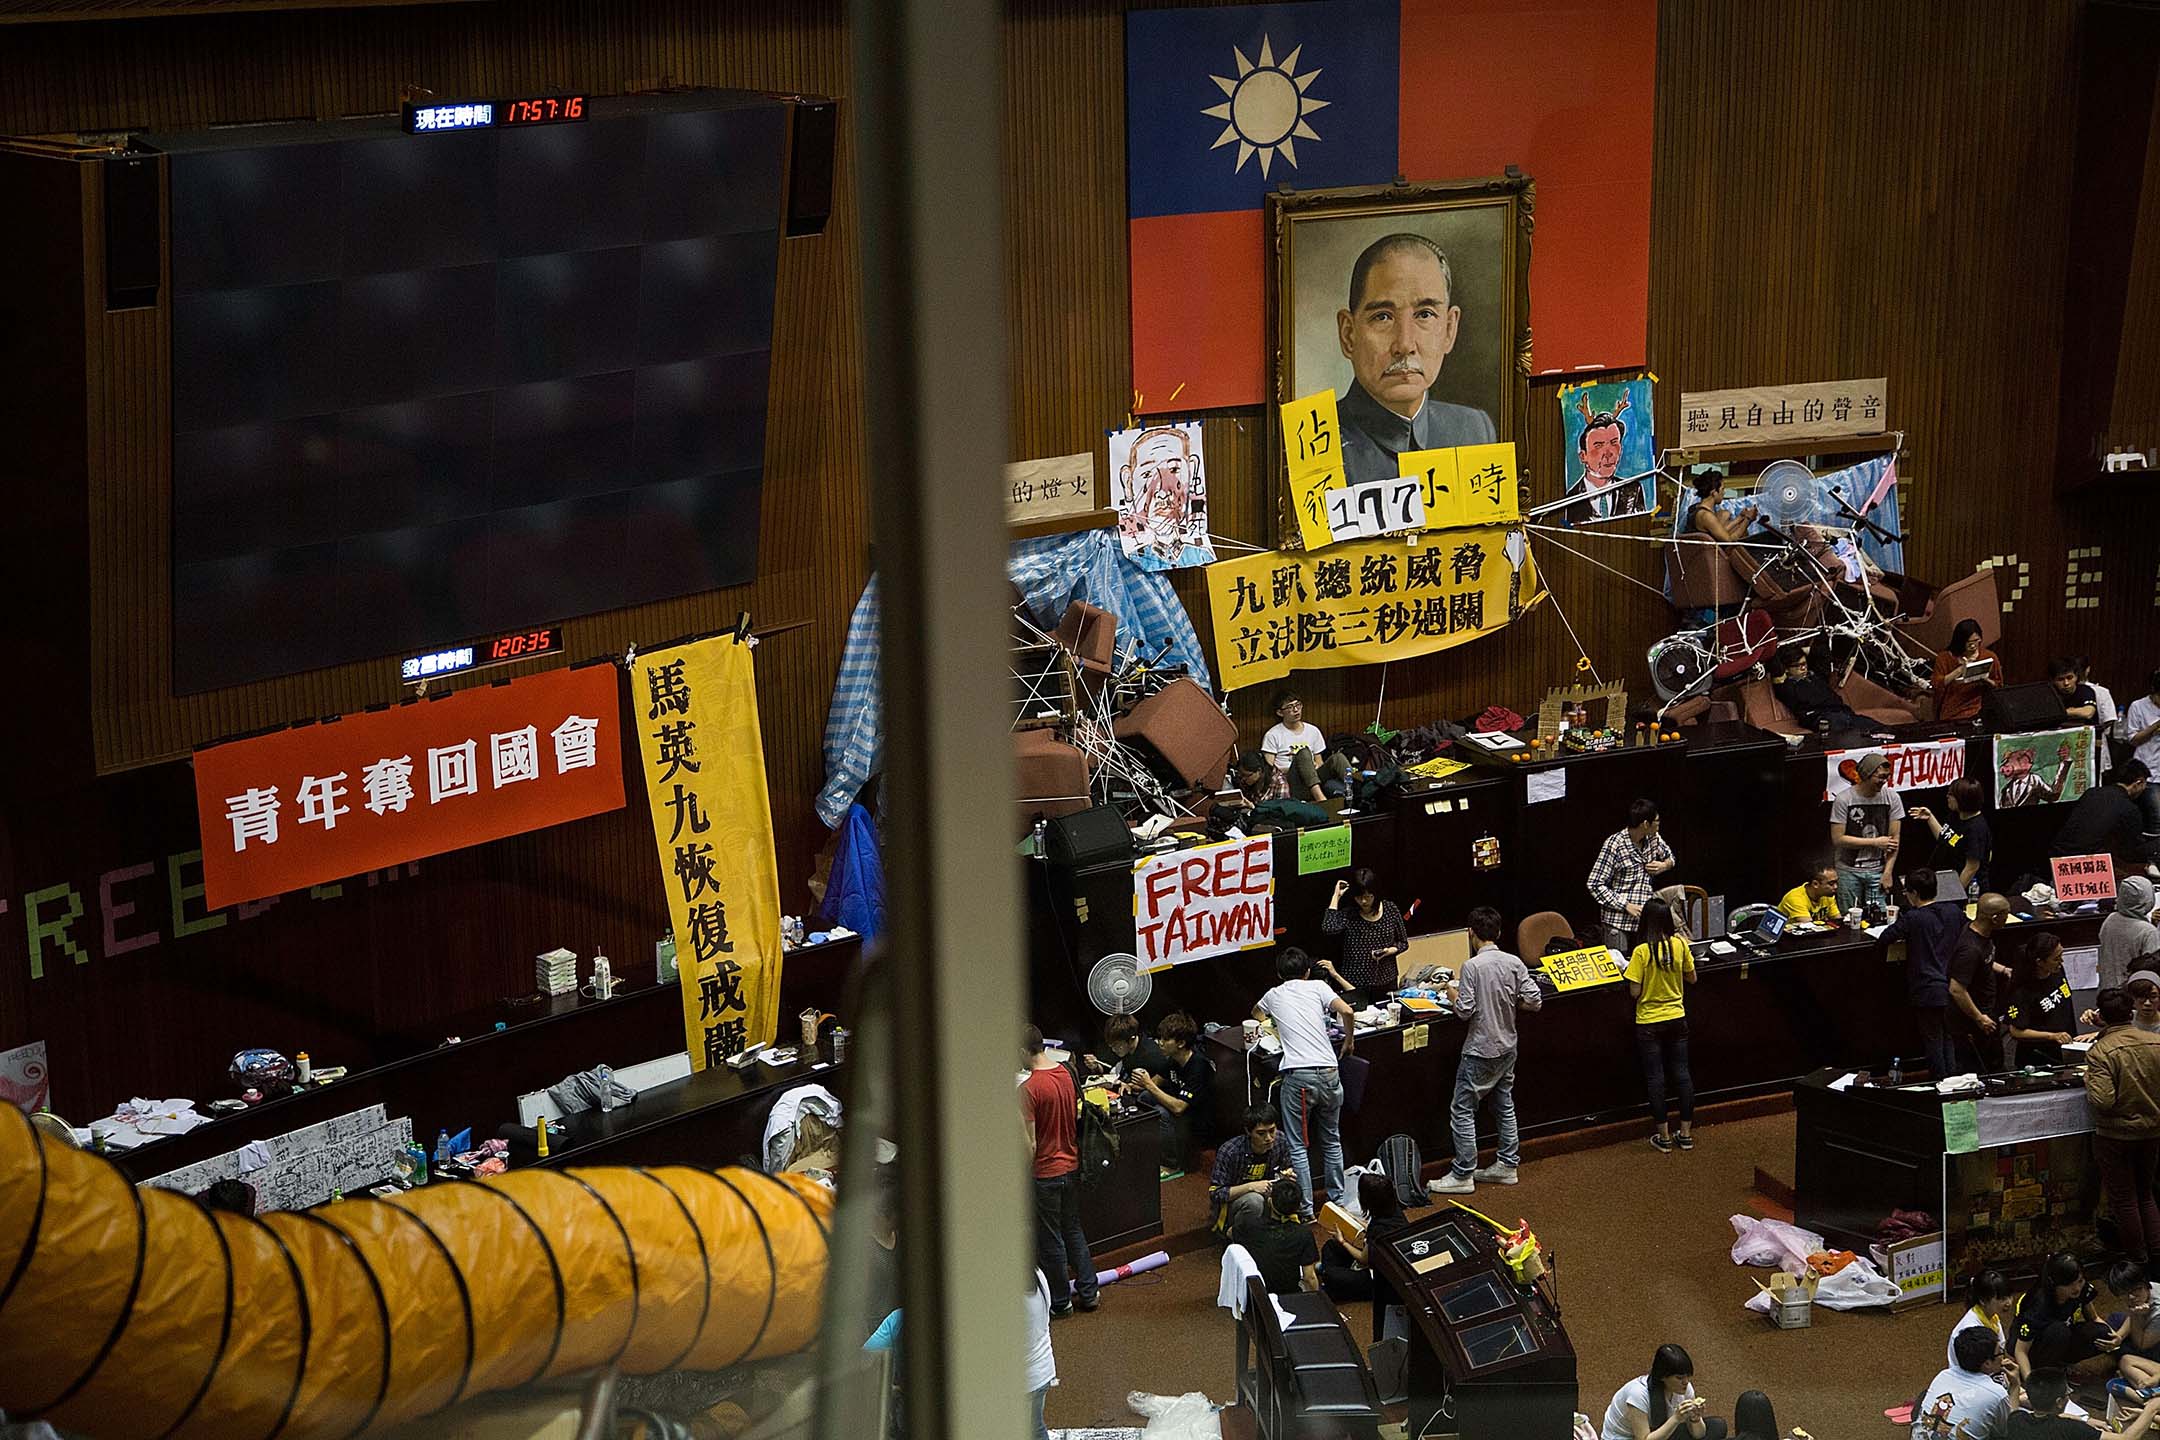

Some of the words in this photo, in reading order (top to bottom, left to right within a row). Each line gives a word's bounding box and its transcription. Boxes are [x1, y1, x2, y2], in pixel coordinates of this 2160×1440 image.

[415, 103, 492, 130] 現在時間
[509, 97, 583, 122] 17:57:16
[1687, 394, 1881, 433] 聽見自由的聲音
[1012, 475, 1088, 504] 的燈火
[1331, 482, 1419, 533] 177
[1419, 463, 1508, 508] 小時
[1228, 542, 1487, 621] 九趴總統威脅
[492, 631, 551, 658] 120:35
[1230, 590, 1485, 669] 立法院三秒過關
[402, 647, 473, 679] 發言時間
[225, 715, 600, 853] 青年奪回國會
[647, 658, 749, 1068] 馬英九恢復戒嚴
[1145, 840, 1271, 920] FREE
[1137, 897, 1272, 962] TAIWAN
[1548, 950, 1620, 985] 媒體區
